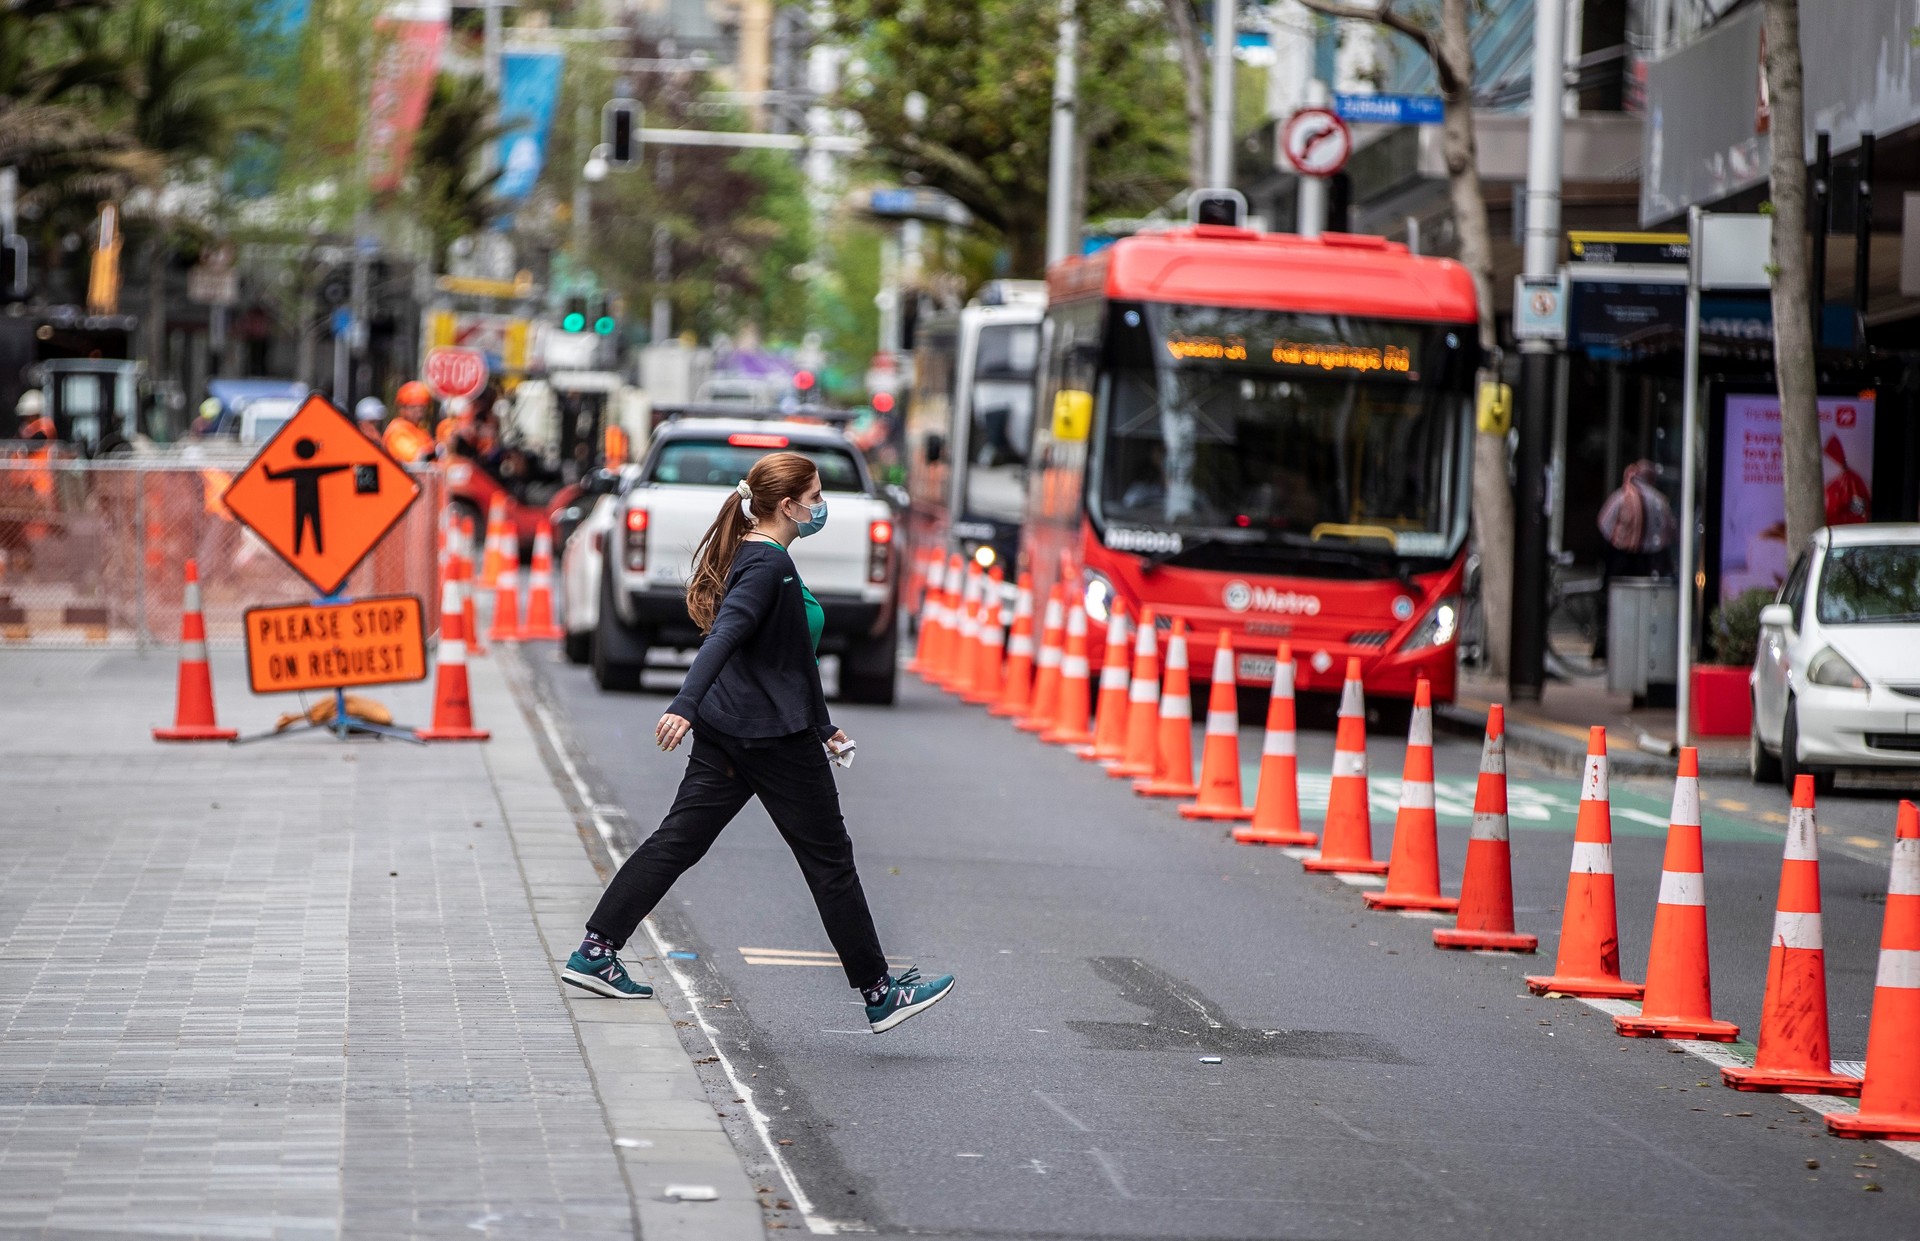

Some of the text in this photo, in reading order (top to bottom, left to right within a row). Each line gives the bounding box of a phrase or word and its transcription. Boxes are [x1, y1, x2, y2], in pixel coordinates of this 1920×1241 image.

[428, 354, 478, 388] STOP
[1252, 585, 1321, 616] Metro
[260, 607, 406, 645] PLEASE STOP
[269, 645, 403, 682] ON REQUEST
